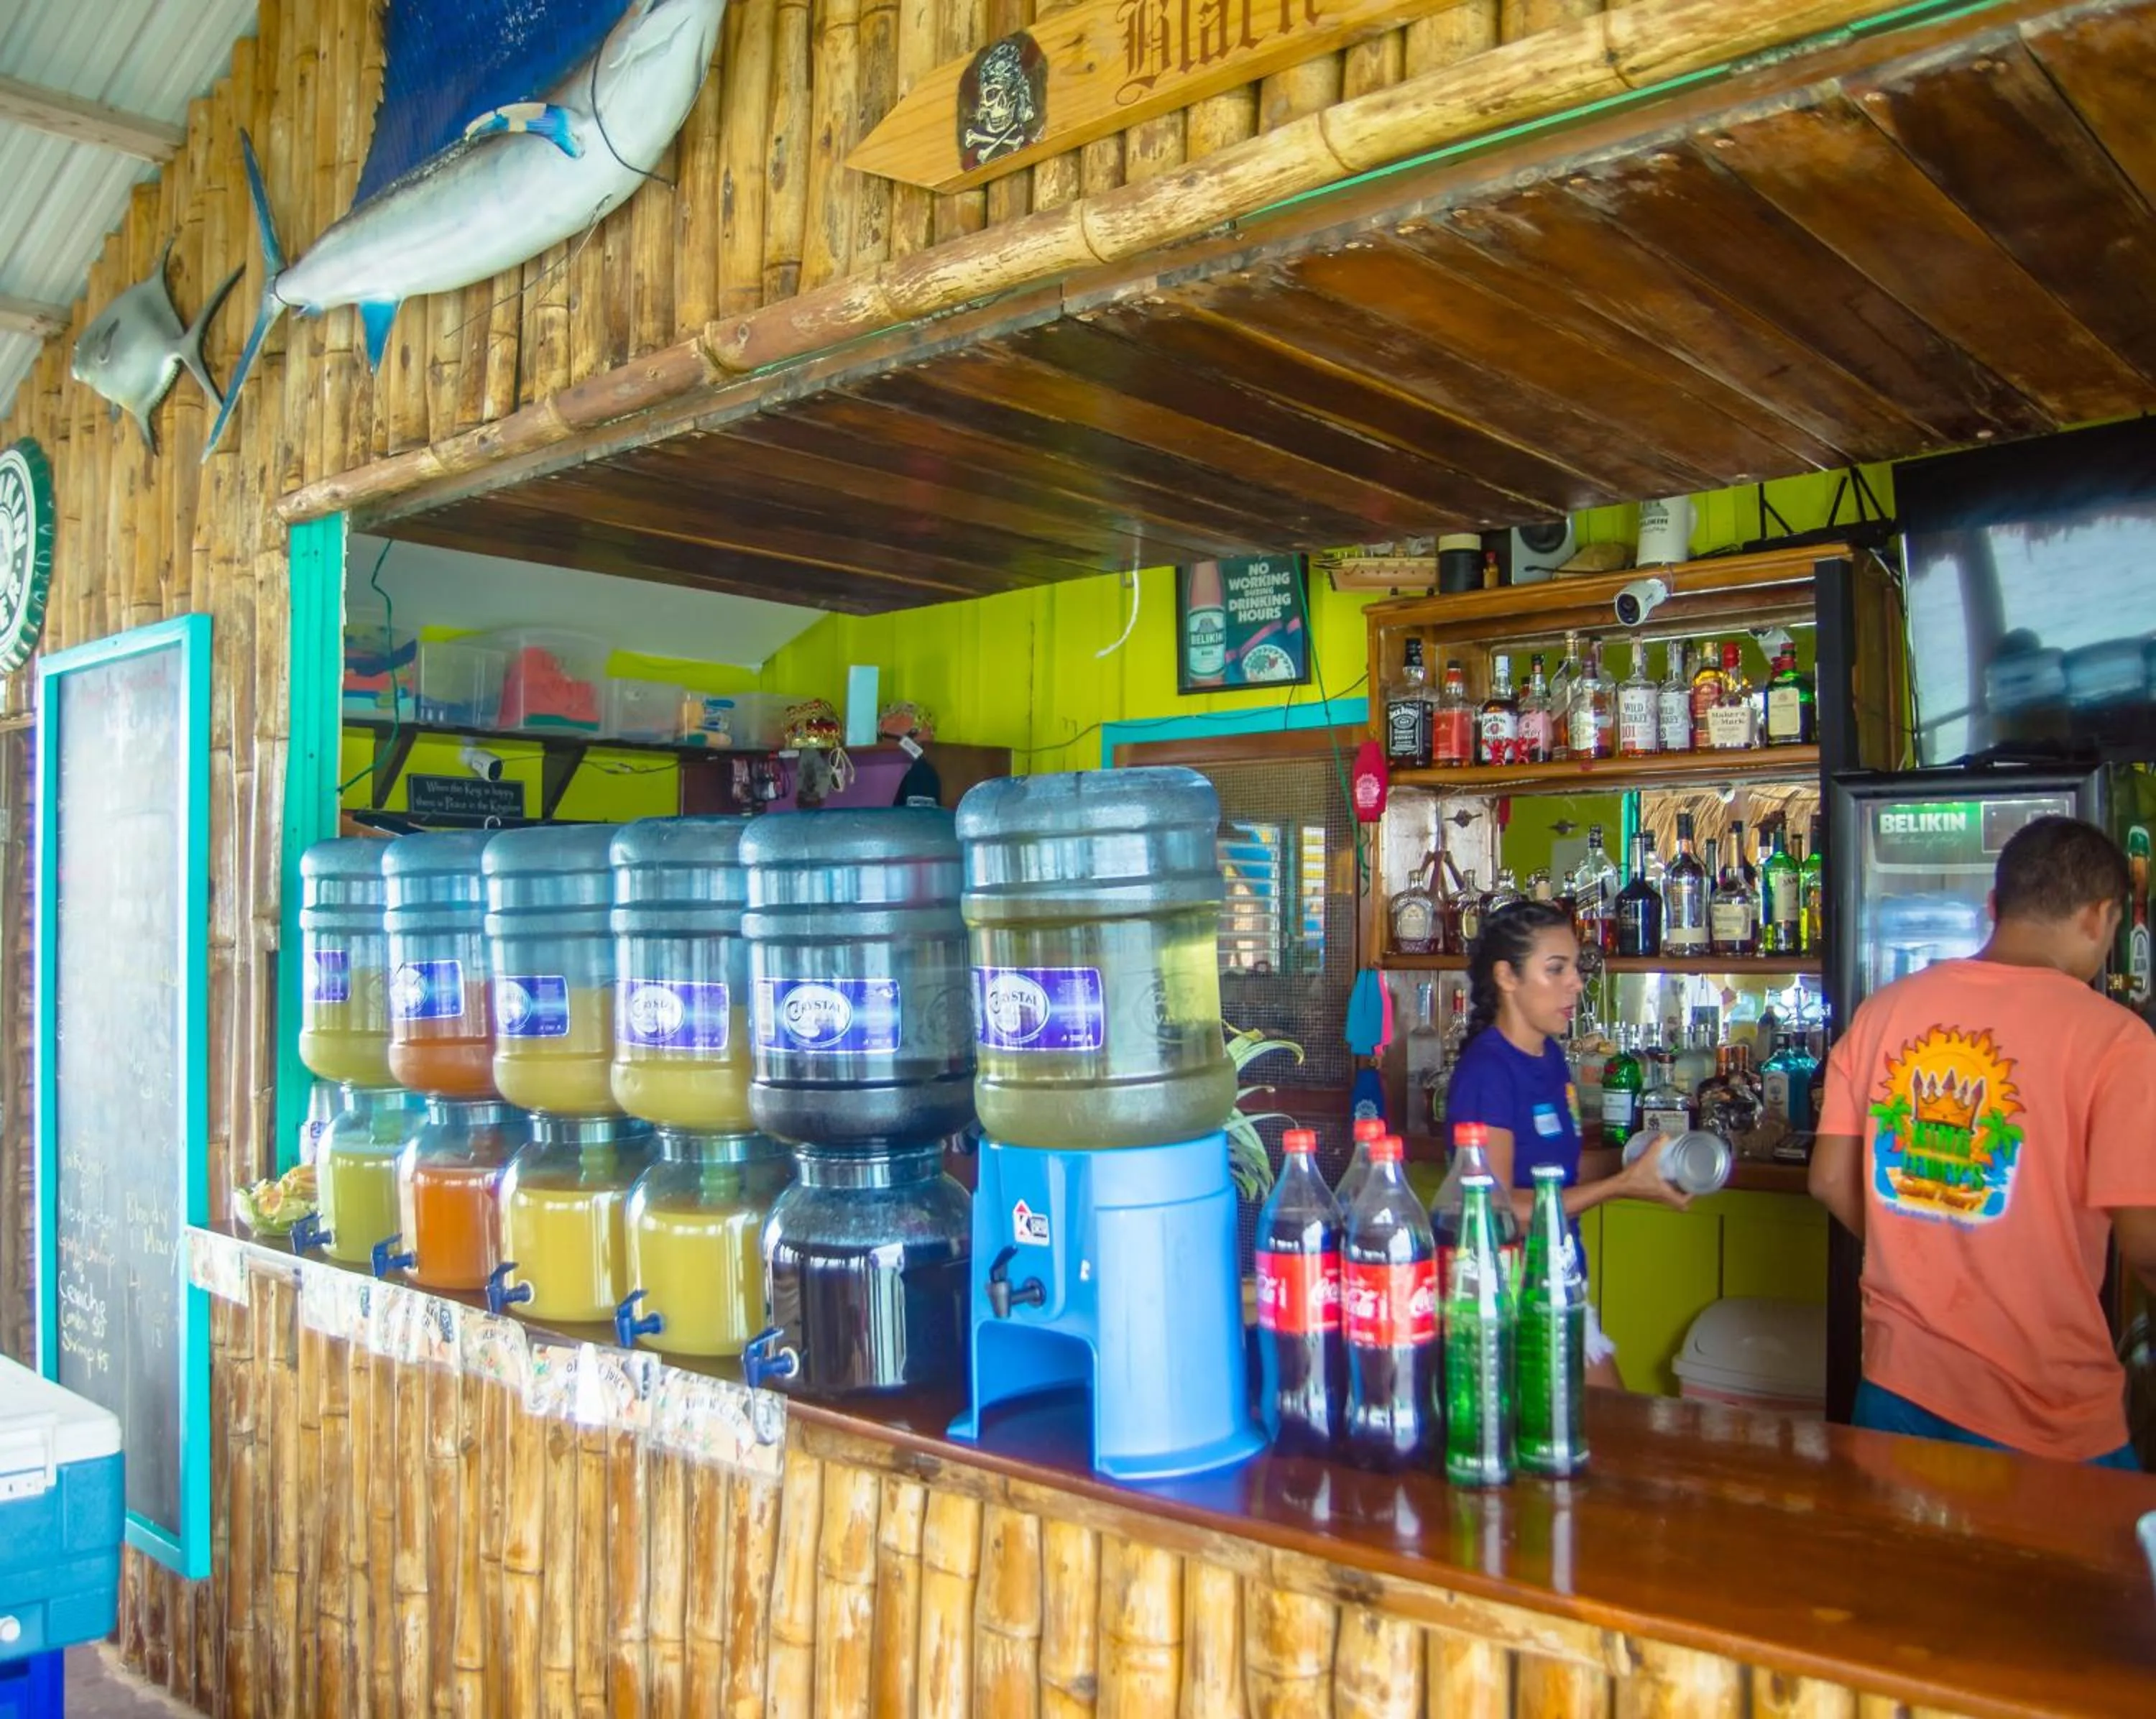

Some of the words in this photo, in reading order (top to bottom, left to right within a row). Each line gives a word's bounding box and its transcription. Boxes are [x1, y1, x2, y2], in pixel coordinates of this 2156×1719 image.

[1248, 562, 1269, 576] NO
[1228, 572, 1291, 591] WORKING
[1228, 593, 1291, 612] DRINKING
[1238, 608, 1281, 623] HOURS
[1623, 701, 1644, 712] WILD
[1879, 812, 1966, 834] BELIKIN
[144, 1225, 180, 1276] Mary
